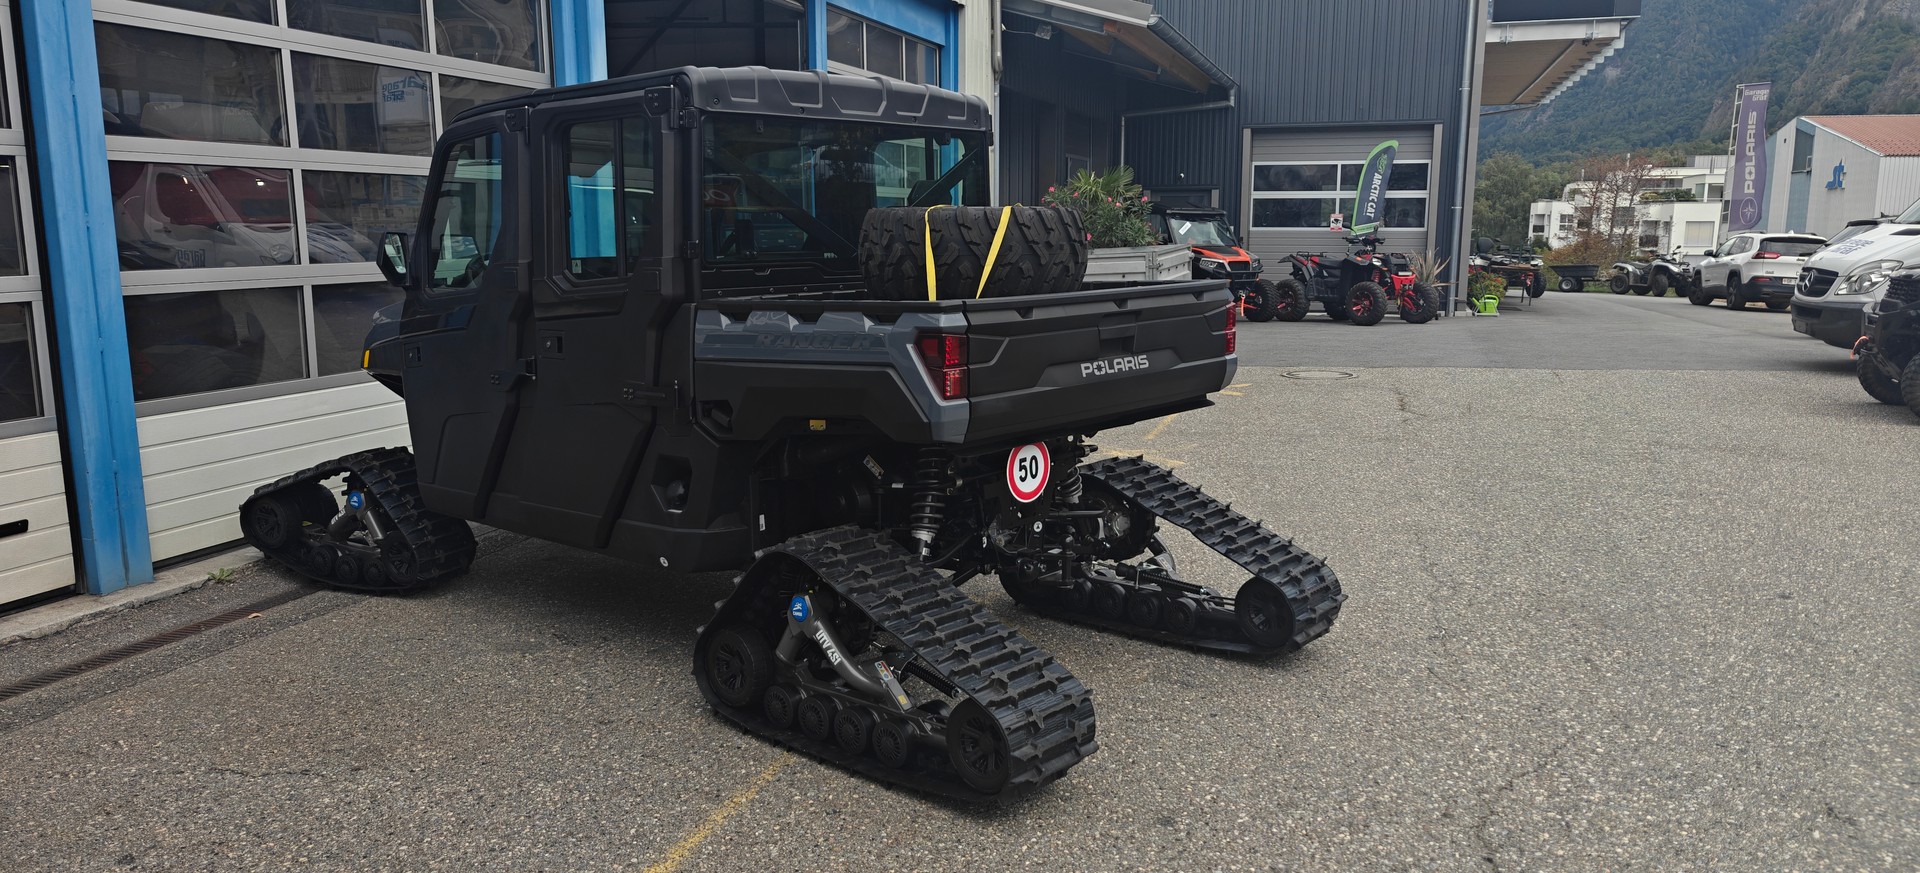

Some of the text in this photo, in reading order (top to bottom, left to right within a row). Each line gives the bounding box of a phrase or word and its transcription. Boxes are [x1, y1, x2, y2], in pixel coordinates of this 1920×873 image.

[1744, 111, 1757, 194] POLARIS
[1370, 172, 1382, 202] ARCTIC
[1366, 202, 1377, 219] CAT
[753, 332, 872, 350] RANGER
[1080, 354, 1149, 378] POLARIS
[1019, 455, 1039, 482] 50
[815, 629, 832, 649] UTV
